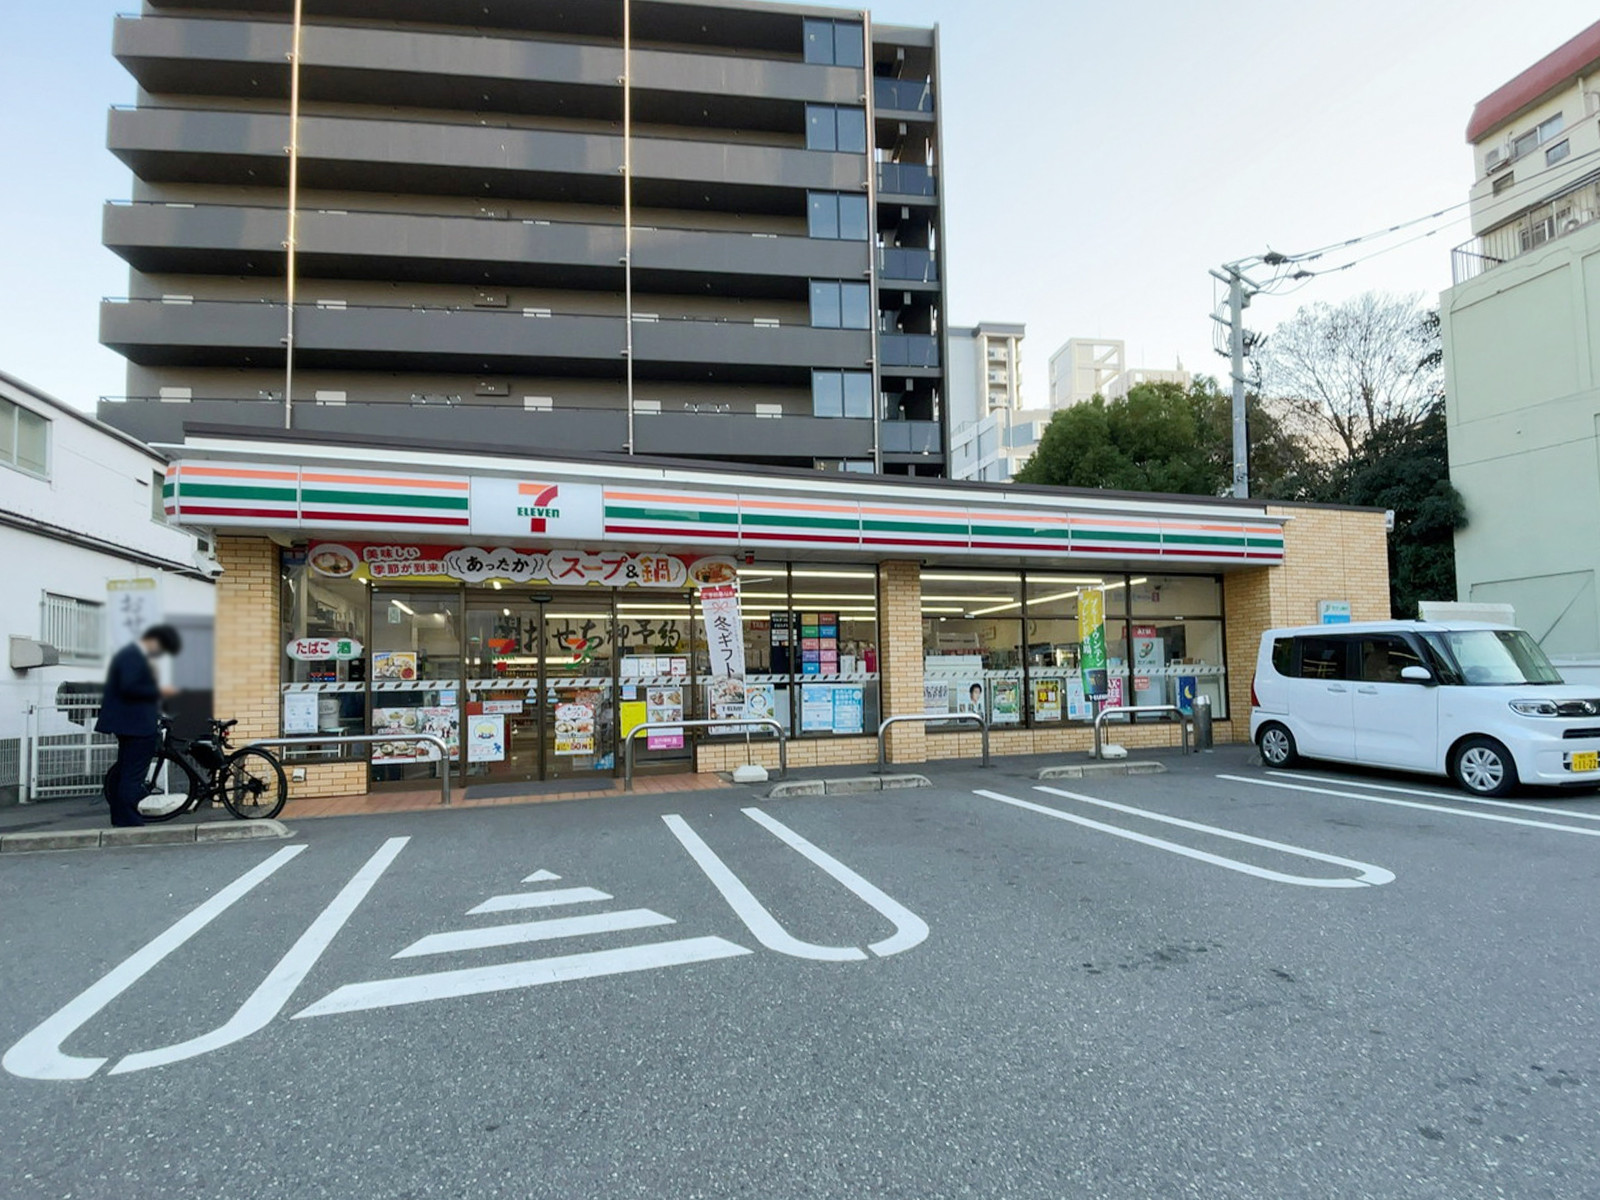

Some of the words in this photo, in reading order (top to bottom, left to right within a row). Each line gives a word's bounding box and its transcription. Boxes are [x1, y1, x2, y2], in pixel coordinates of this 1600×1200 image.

[365, 548, 419, 559] 美味しい
[466, 556, 530, 573] あったか
[559, 555, 671, 583] スープ&鍋
[296, 641, 330, 655] たばこ
[337, 641, 352, 655] 酒
[713, 615, 735, 679] 冬ギフト
